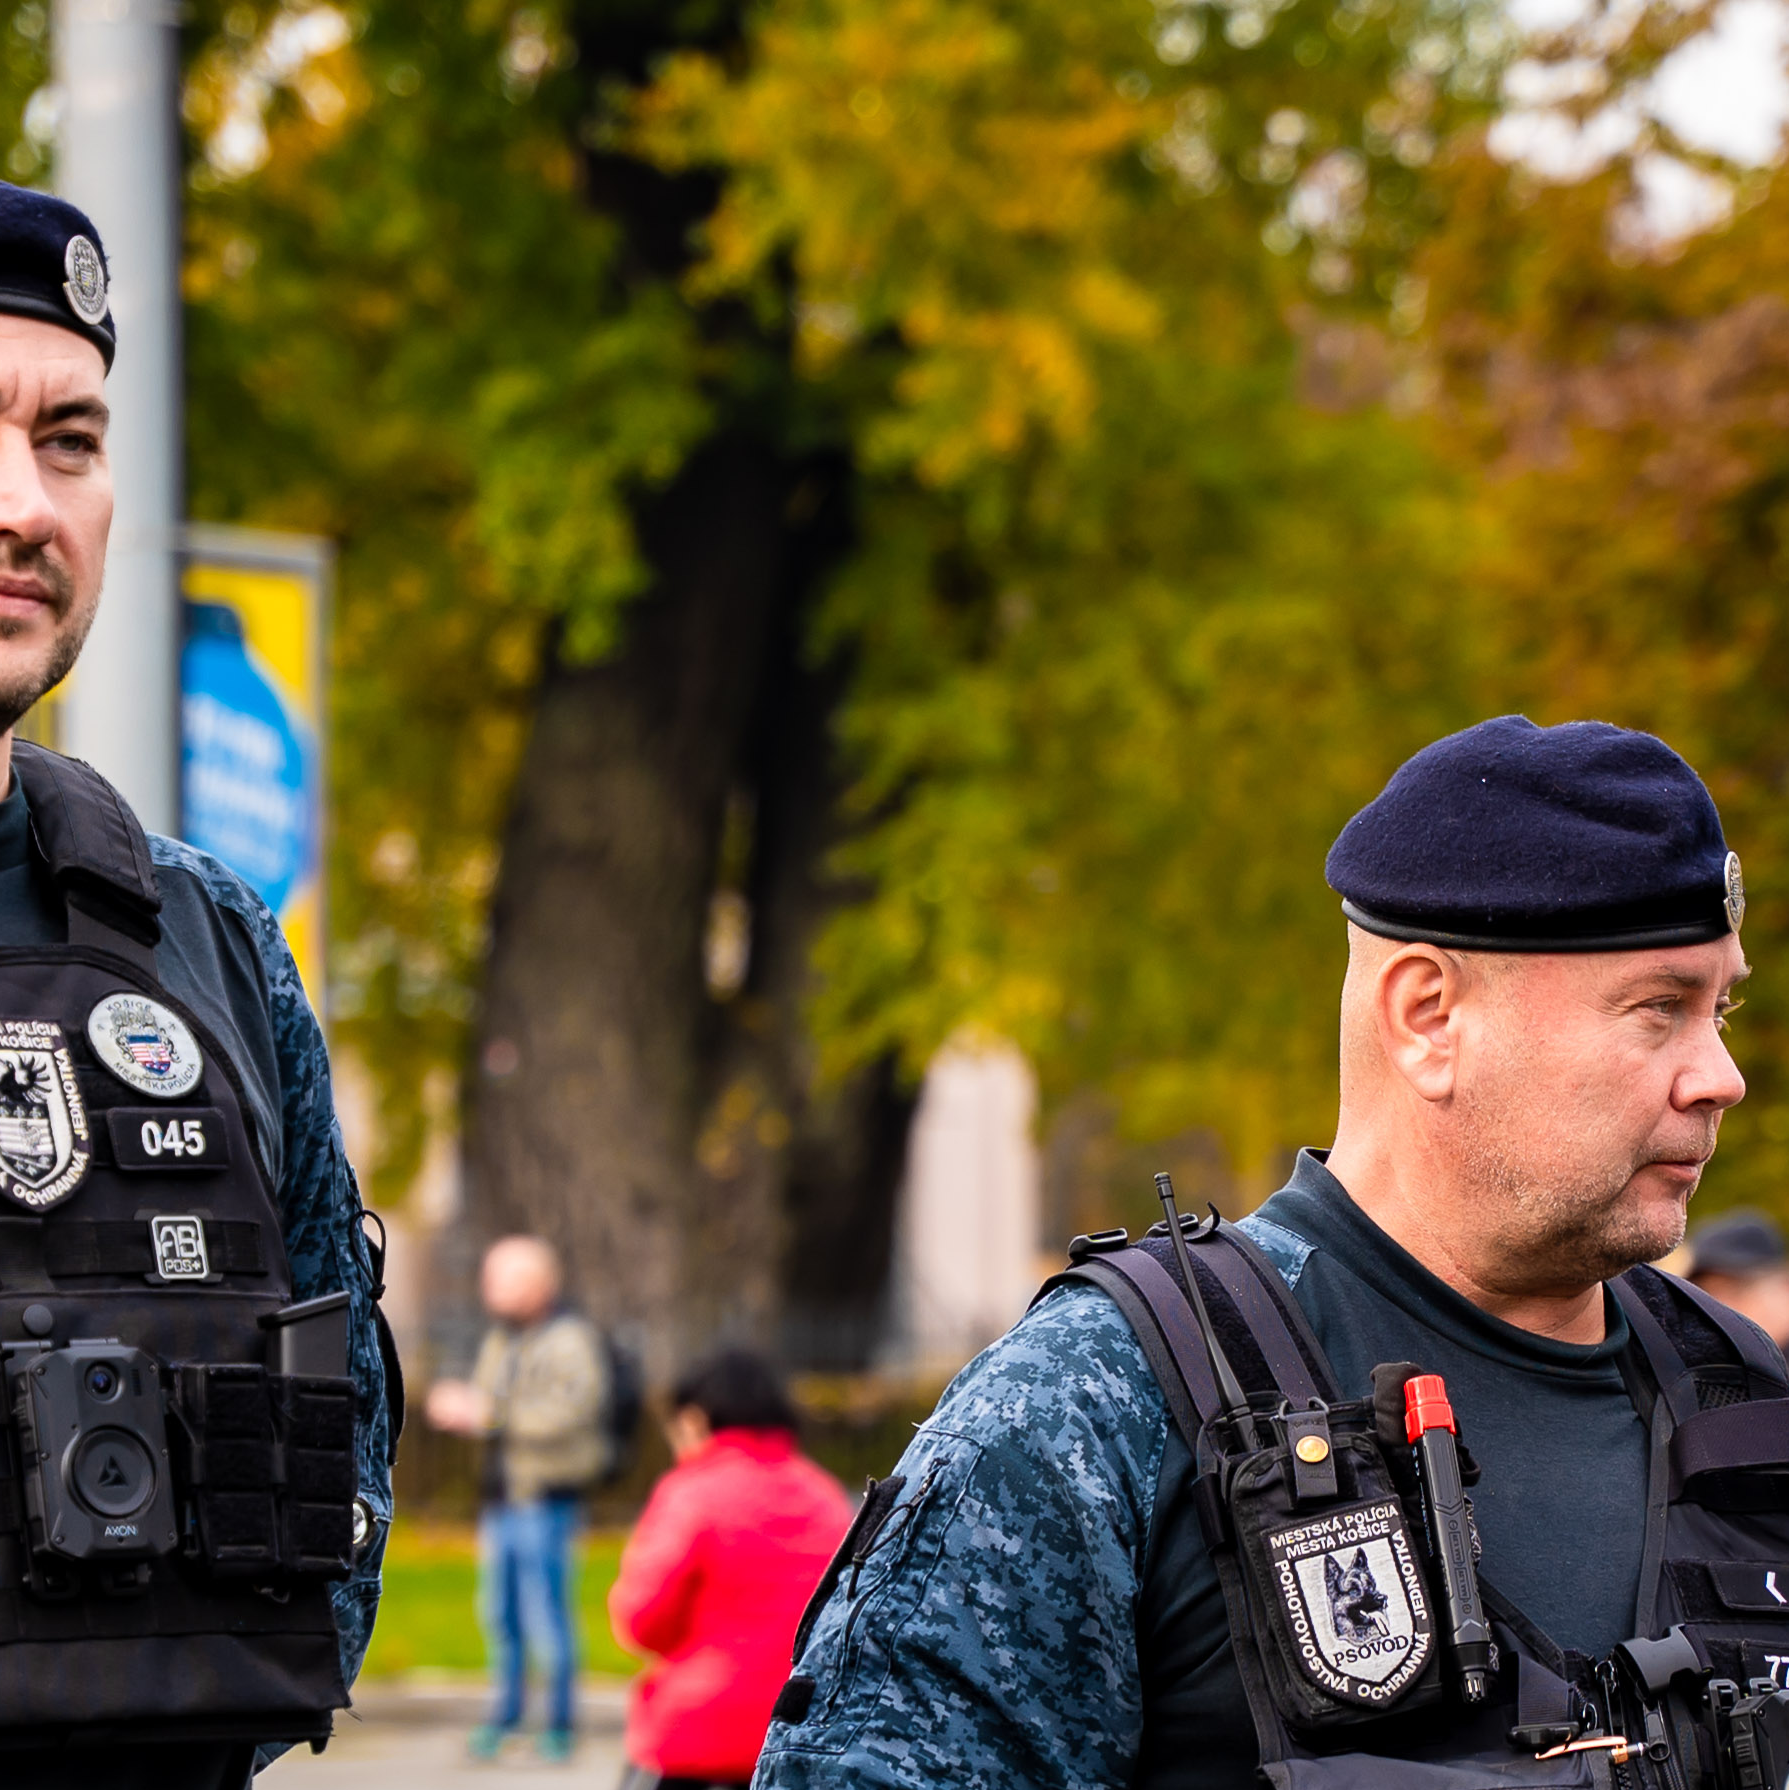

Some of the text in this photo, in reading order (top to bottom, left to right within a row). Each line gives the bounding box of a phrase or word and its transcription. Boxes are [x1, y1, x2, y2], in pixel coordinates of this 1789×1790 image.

[105, 998, 152, 1012] KOŠICE
[0, 1034, 54, 1049] KOŠICE
[5, 1020, 61, 1037] POLÍCIA
[54, 1047, 90, 1142] JEDNOTKA
[141, 1119, 206, 1157] 045
[12, 1148, 90, 1206] OCHRANNÁ
[160, 1225, 198, 1258] AB
[164, 1258, 201, 1273] POS+
[104, 1525, 138, 1537] AXON
[1269, 1504, 1399, 1549] MESTSKÁ POLÍCIA
[1285, 1520, 1390, 1560] MESTA KOŠICE
[1391, 1528, 1428, 1620] JEDNOTKA
[1274, 1559, 1430, 1701] POHOTOVOSTNÁ OCHRANNÁ
[1333, 1634, 1409, 1667] PSOVOD
